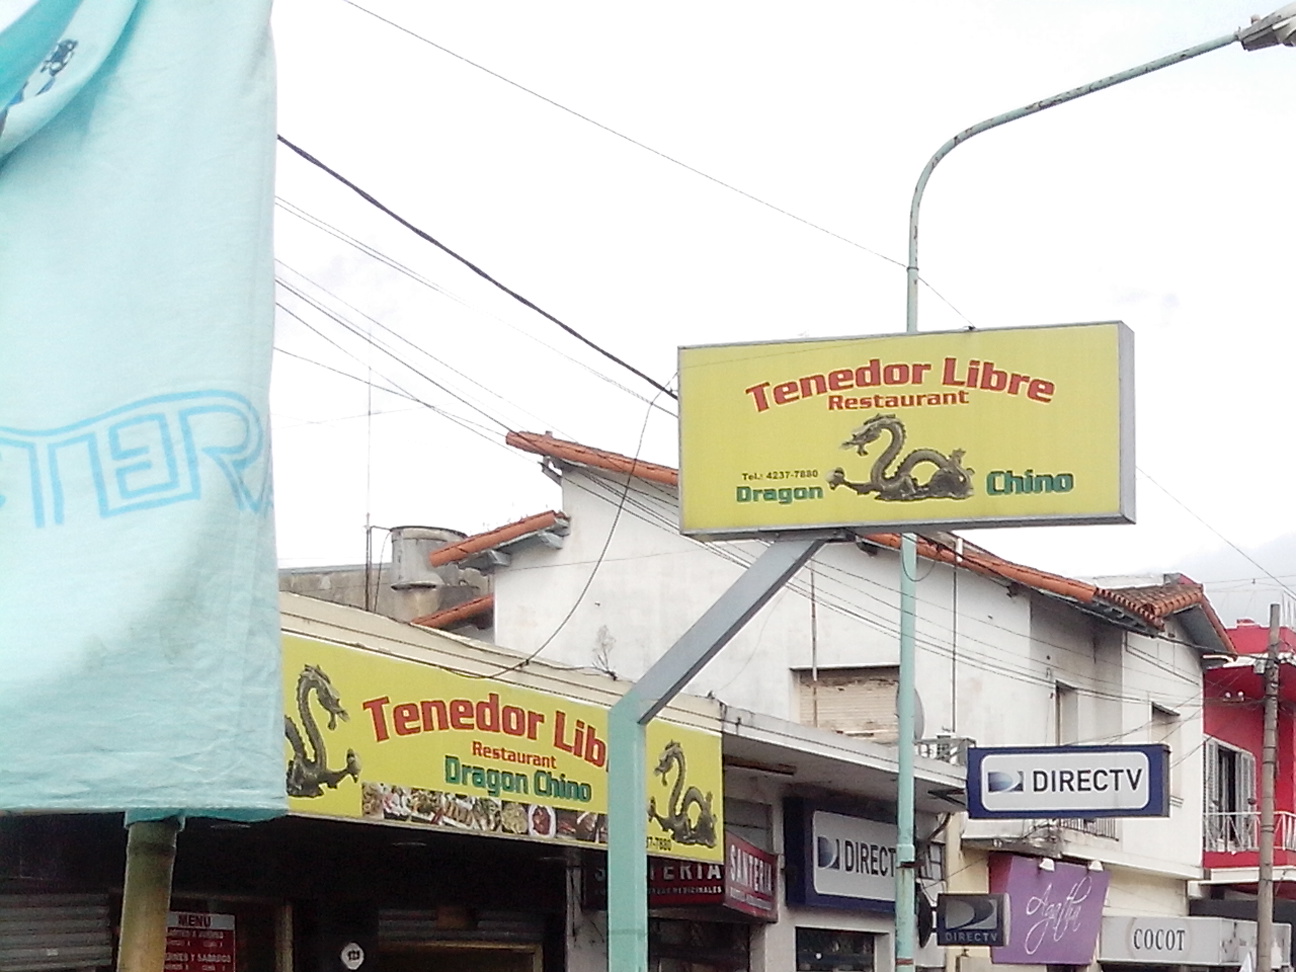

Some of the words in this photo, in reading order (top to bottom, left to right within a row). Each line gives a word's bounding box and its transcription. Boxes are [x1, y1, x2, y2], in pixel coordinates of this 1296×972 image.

[745, 358, 931, 413] Tenedor
[941, 357, 1056, 404] Libre
[828, 390, 970, 411] Restaurant
[736, 486, 823, 504] Dragon
[986, 469, 1074, 496] Chino
[766, 470, 818, 479] 4237-7880
[363, 693, 544, 742] Tenedor
[554, 710, 609, 769] Lib
[472, 741, 557, 769] Restaurant
[445, 755, 529, 797] Dragon
[534, 769, 592, 802] Chino
[1033, 769, 1143, 792] DIRECTV
[845, 840, 896, 878] DIRECT
[178, 914, 211, 928] MENU
[945, 932, 997, 942] DIRECTV
[1133, 928, 1186, 951] COCOT
